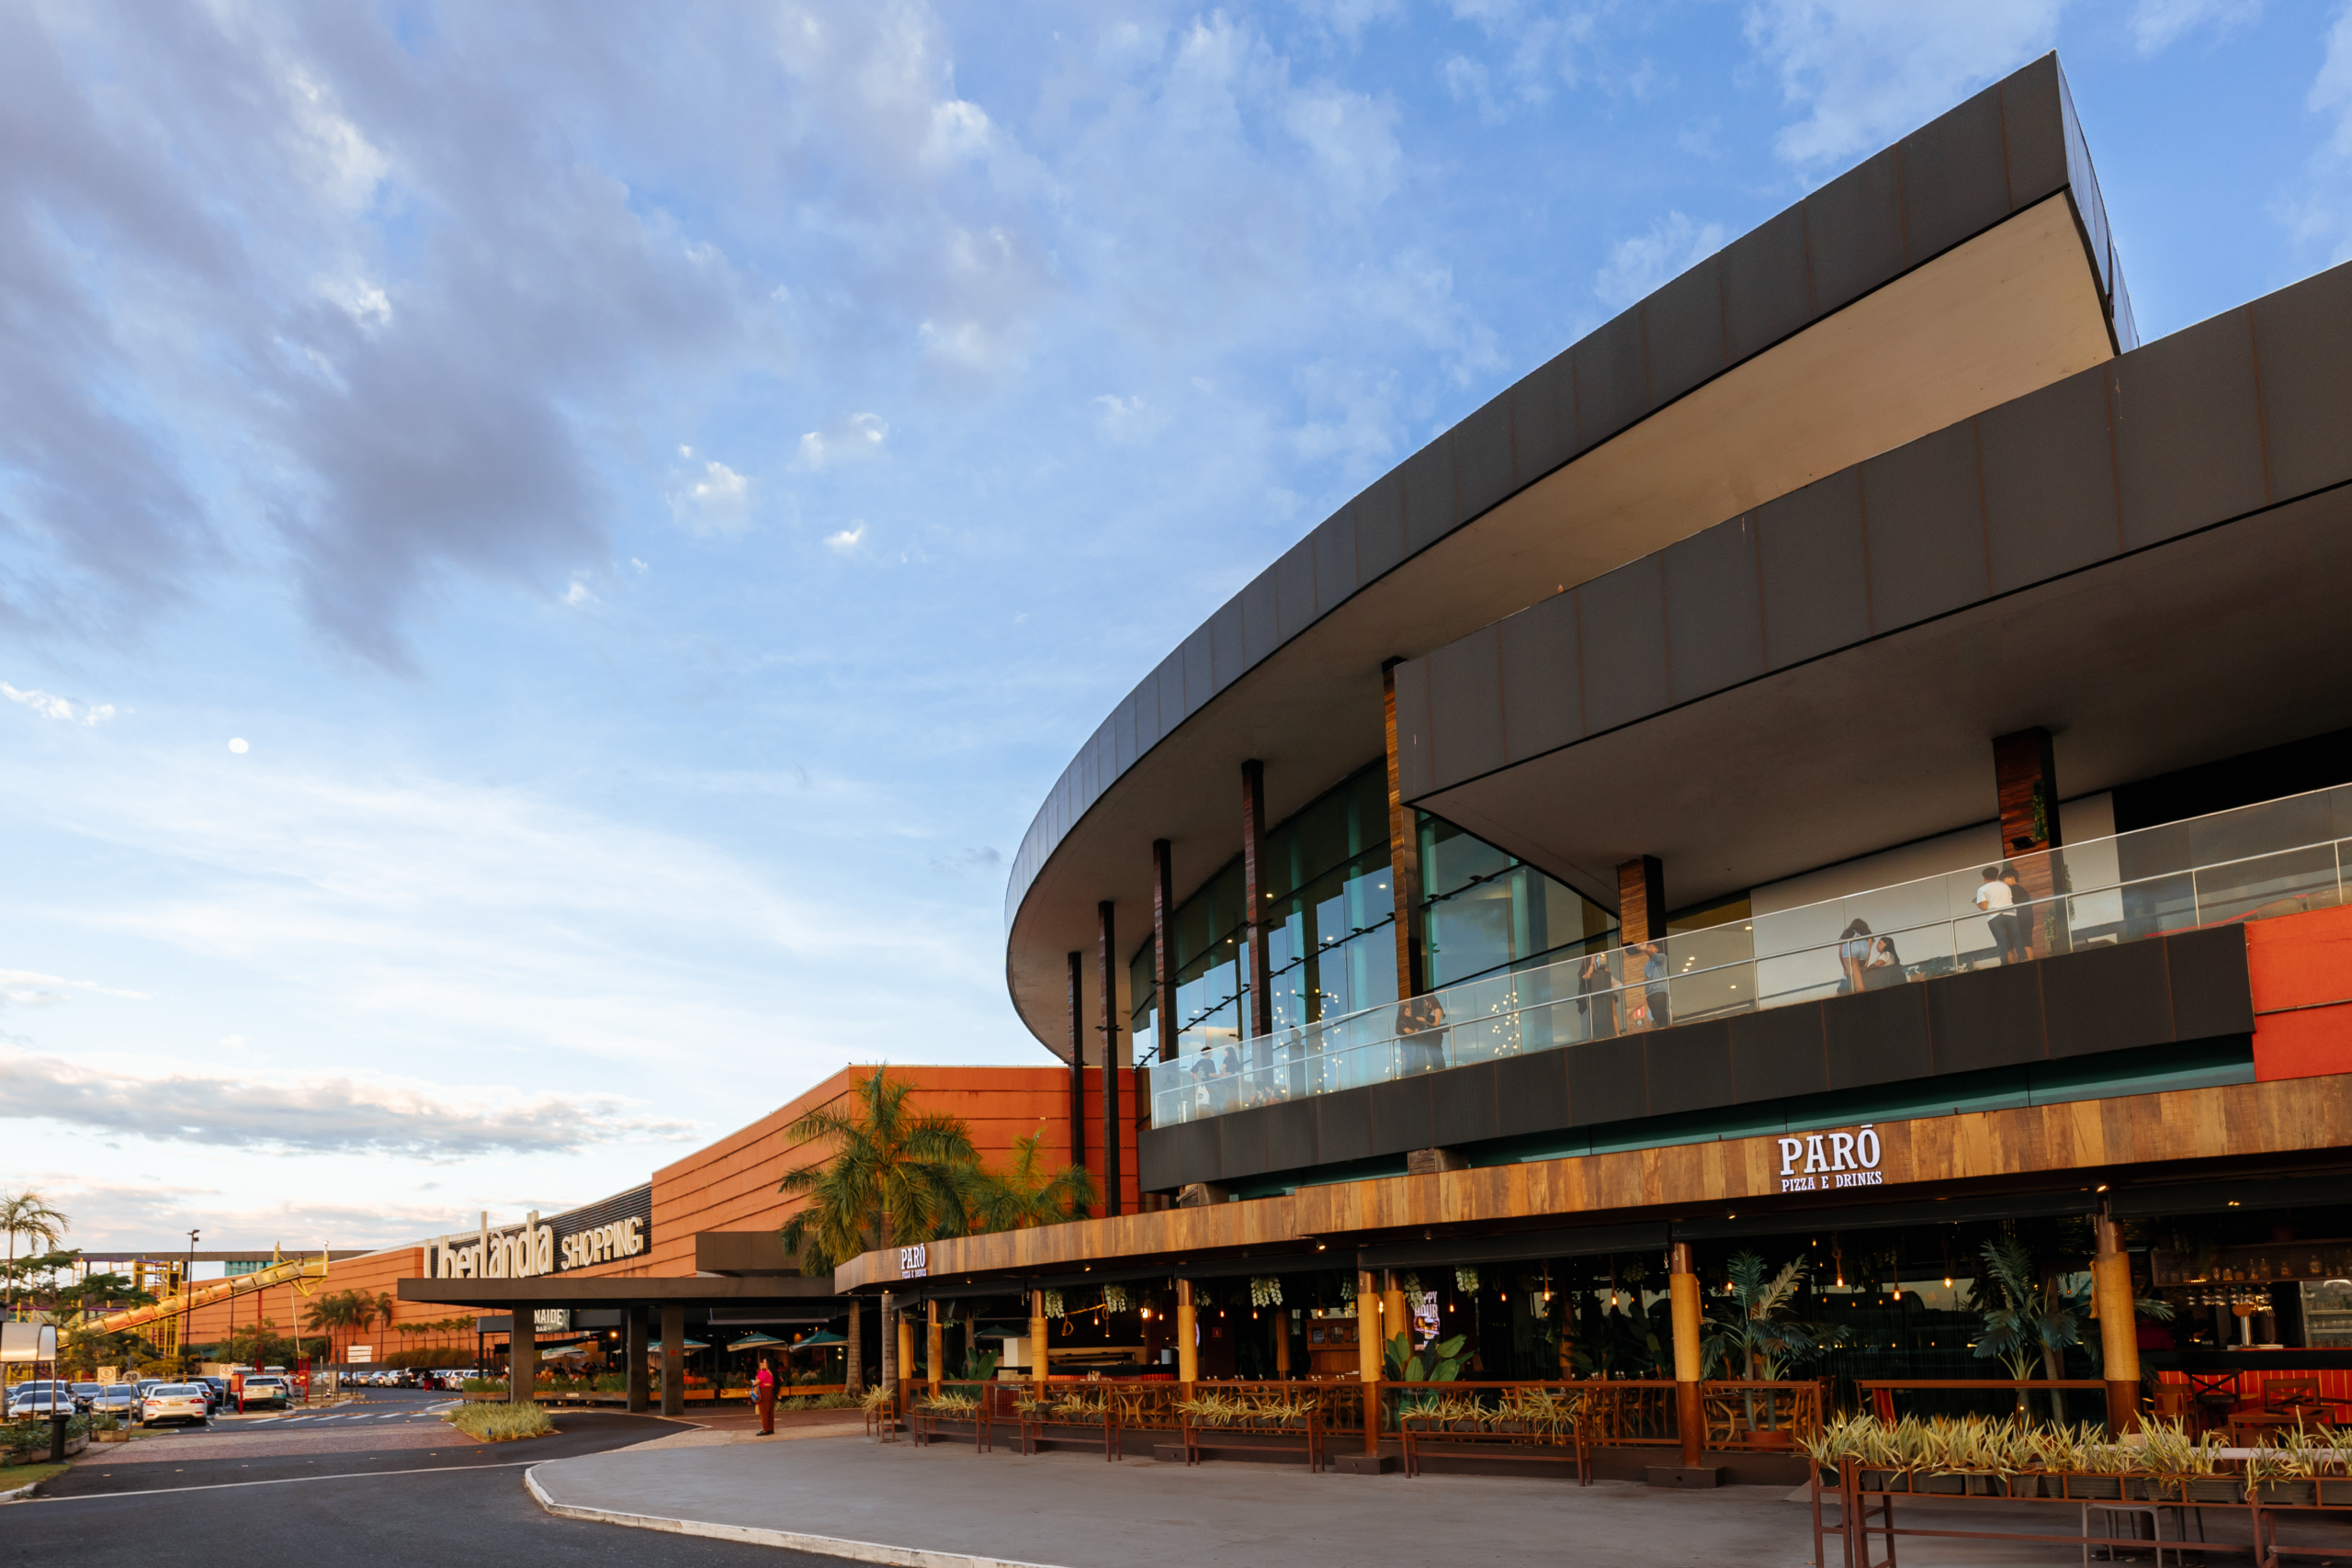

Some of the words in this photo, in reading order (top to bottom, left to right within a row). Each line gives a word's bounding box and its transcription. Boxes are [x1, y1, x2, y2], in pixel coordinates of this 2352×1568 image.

[1781, 1176, 1816, 1192] PIZZA
[1821, 1175, 1829, 1190] E
[1835, 1170, 1883, 1188] DRINKS
[560, 1216, 644, 1270] SHOPPING
[126, 1373, 138, 1382] 20
